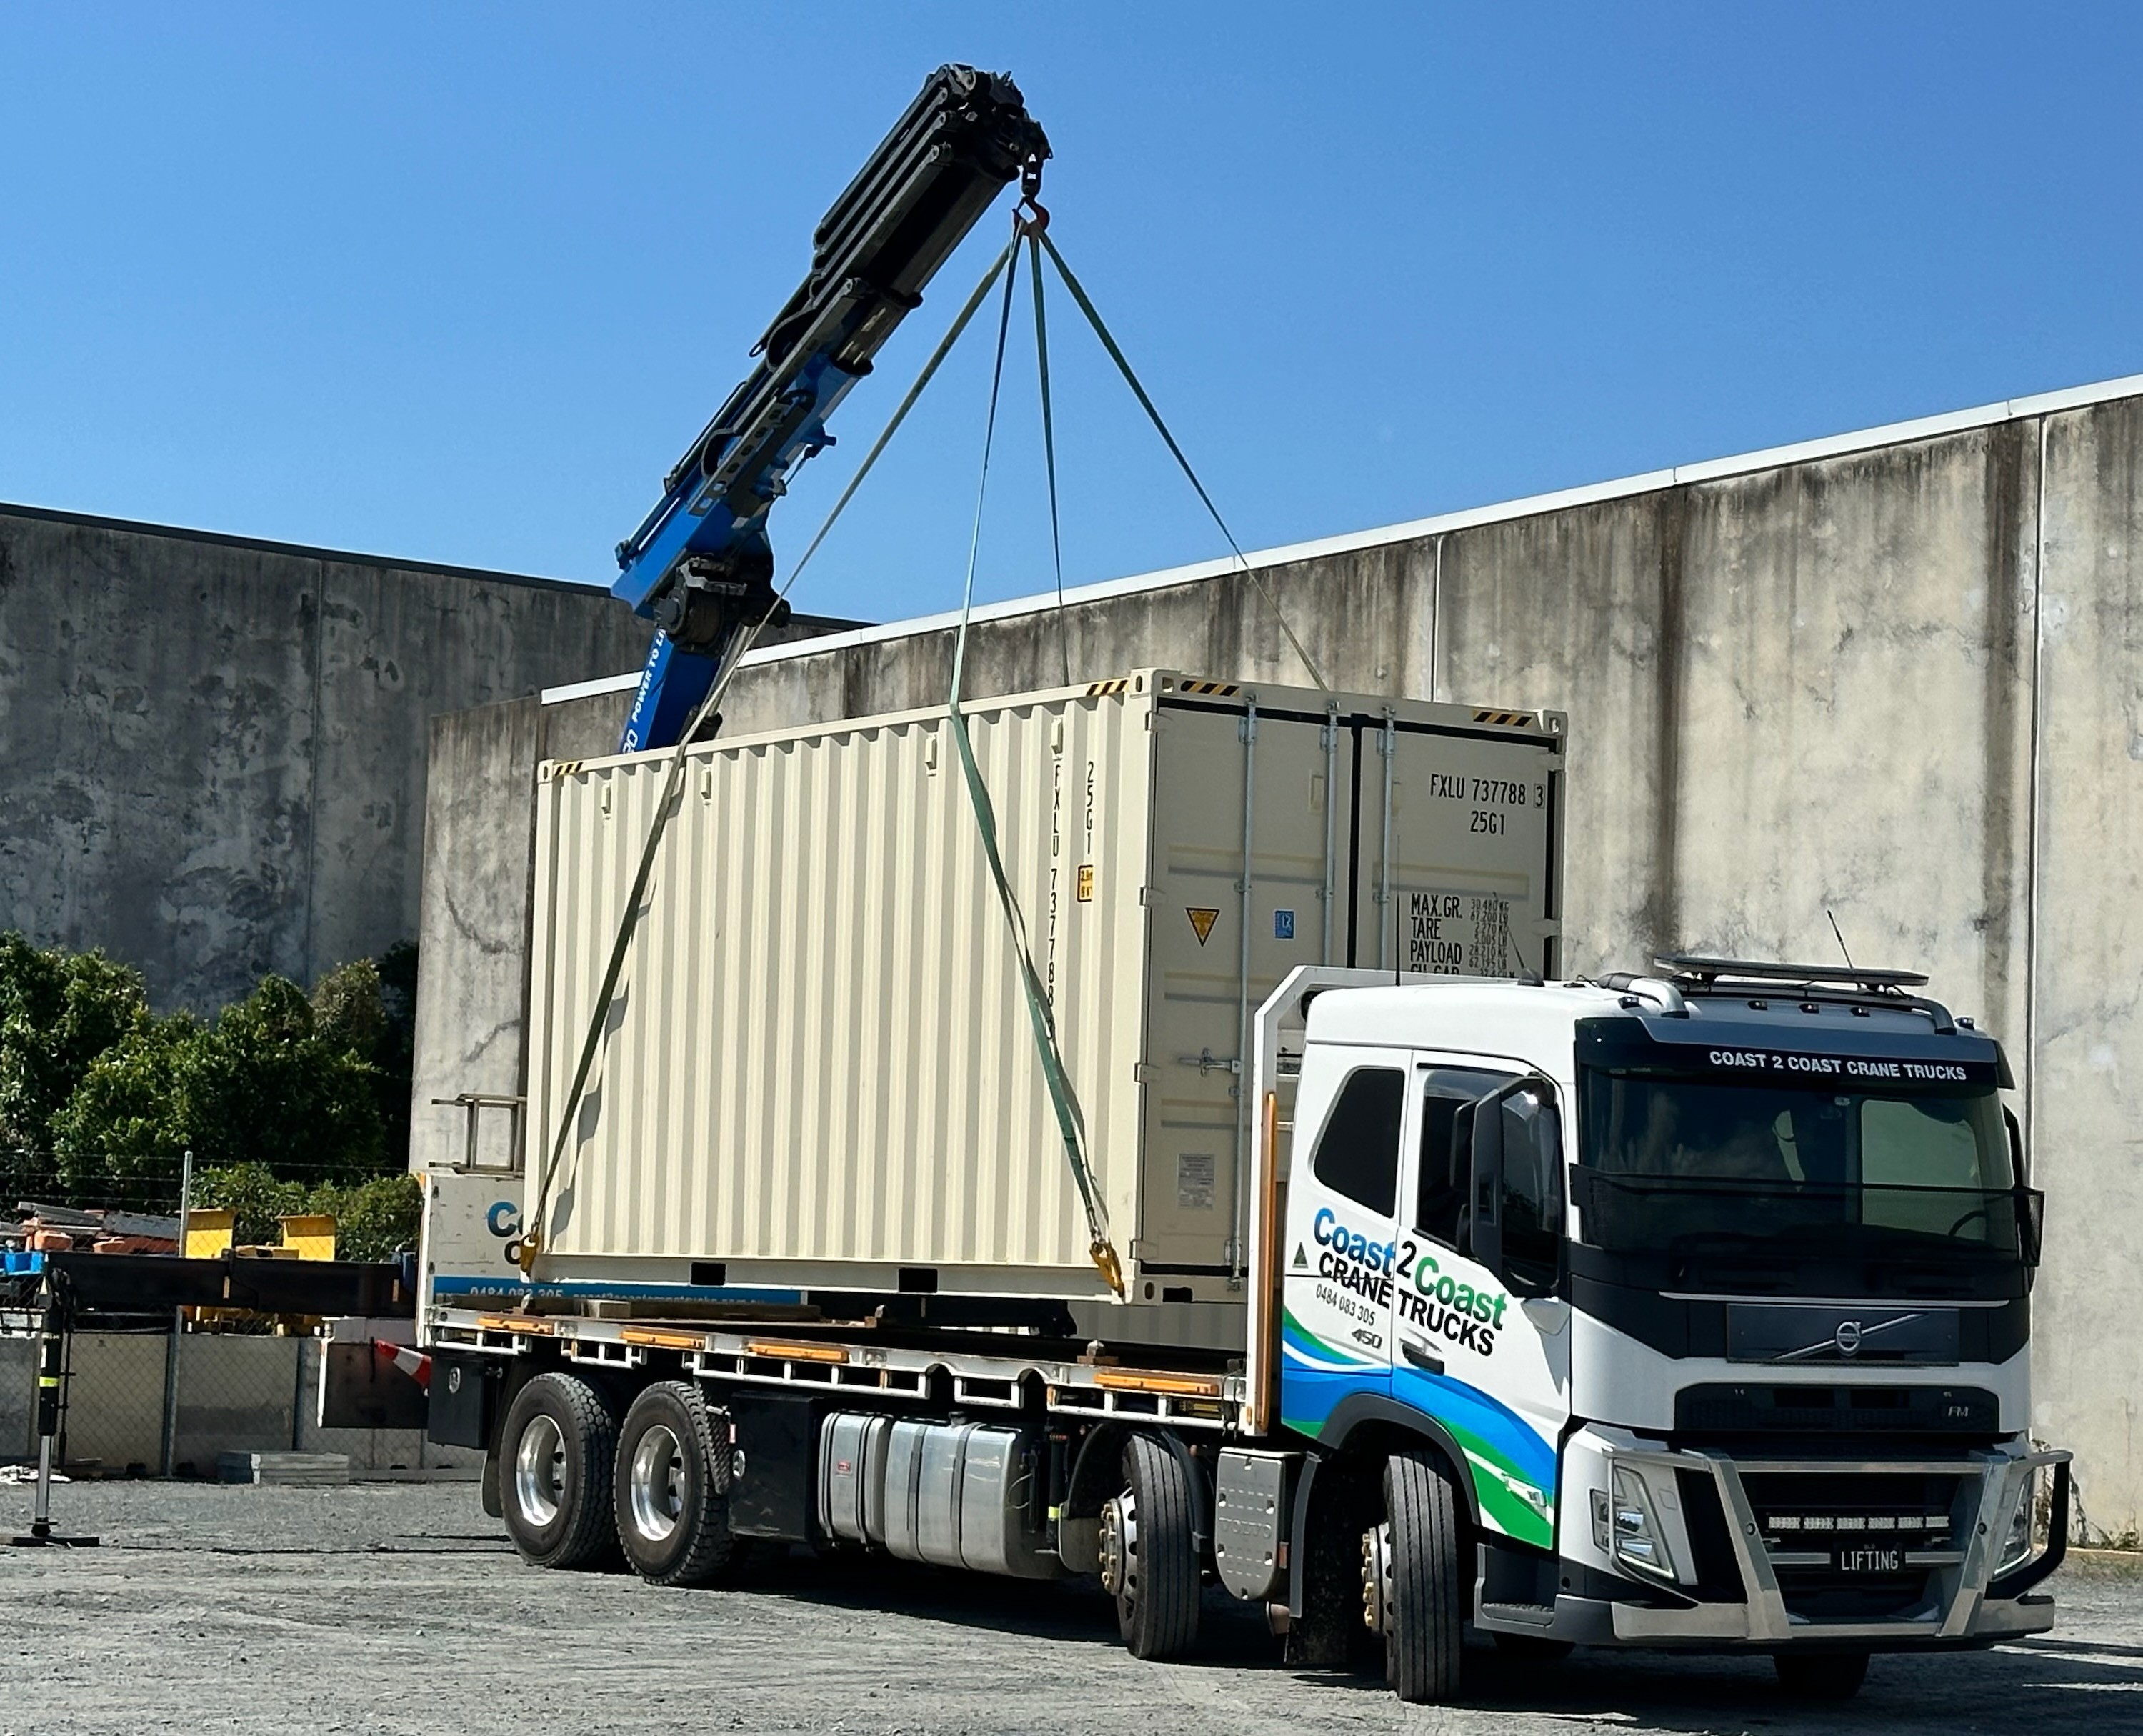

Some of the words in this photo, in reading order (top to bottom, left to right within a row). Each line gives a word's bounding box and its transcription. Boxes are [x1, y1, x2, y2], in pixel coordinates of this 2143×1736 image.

[631, 669, 653, 724] POWER
[646, 647, 659, 668] TO
[1430, 774, 1465, 799] FXLU
[1472, 779, 1527, 806] 737788
[1535, 784, 1544, 807] 3
[1051, 764, 1062, 858] FXLU
[1470, 811, 1506, 835] 25G1
[1046, 867, 1059, 1008] 737788
[1411, 917, 1442, 939] TARE
[1410, 939, 1463, 964] PAYLOAD
[1709, 1051, 1767, 1068] COAST
[1772, 1056, 1784, 1069] 2
[1788, 1056, 1842, 1074] COAST
[1847, 1061, 1901, 1078] CRANE
[1903, 1064, 1967, 1081] TRUCKS
[1314, 1207, 1396, 1278] Coast
[1395, 1240, 1417, 1279] 2
[1414, 1256, 1507, 1330] Coast
[1316, 1283, 1338, 1307] 0484
[1339, 1294, 1357, 1317] 083
[1357, 1305, 1377, 1327] 305
[1319, 1252, 1394, 1310] CRANE
[1398, 1287, 1495, 1357] TRUCKS
[1947, 1405, 1969, 1418] FM
[1219, 1516, 1272, 1540] VOLVO
[1841, 1550, 1899, 1571] LIFTING
